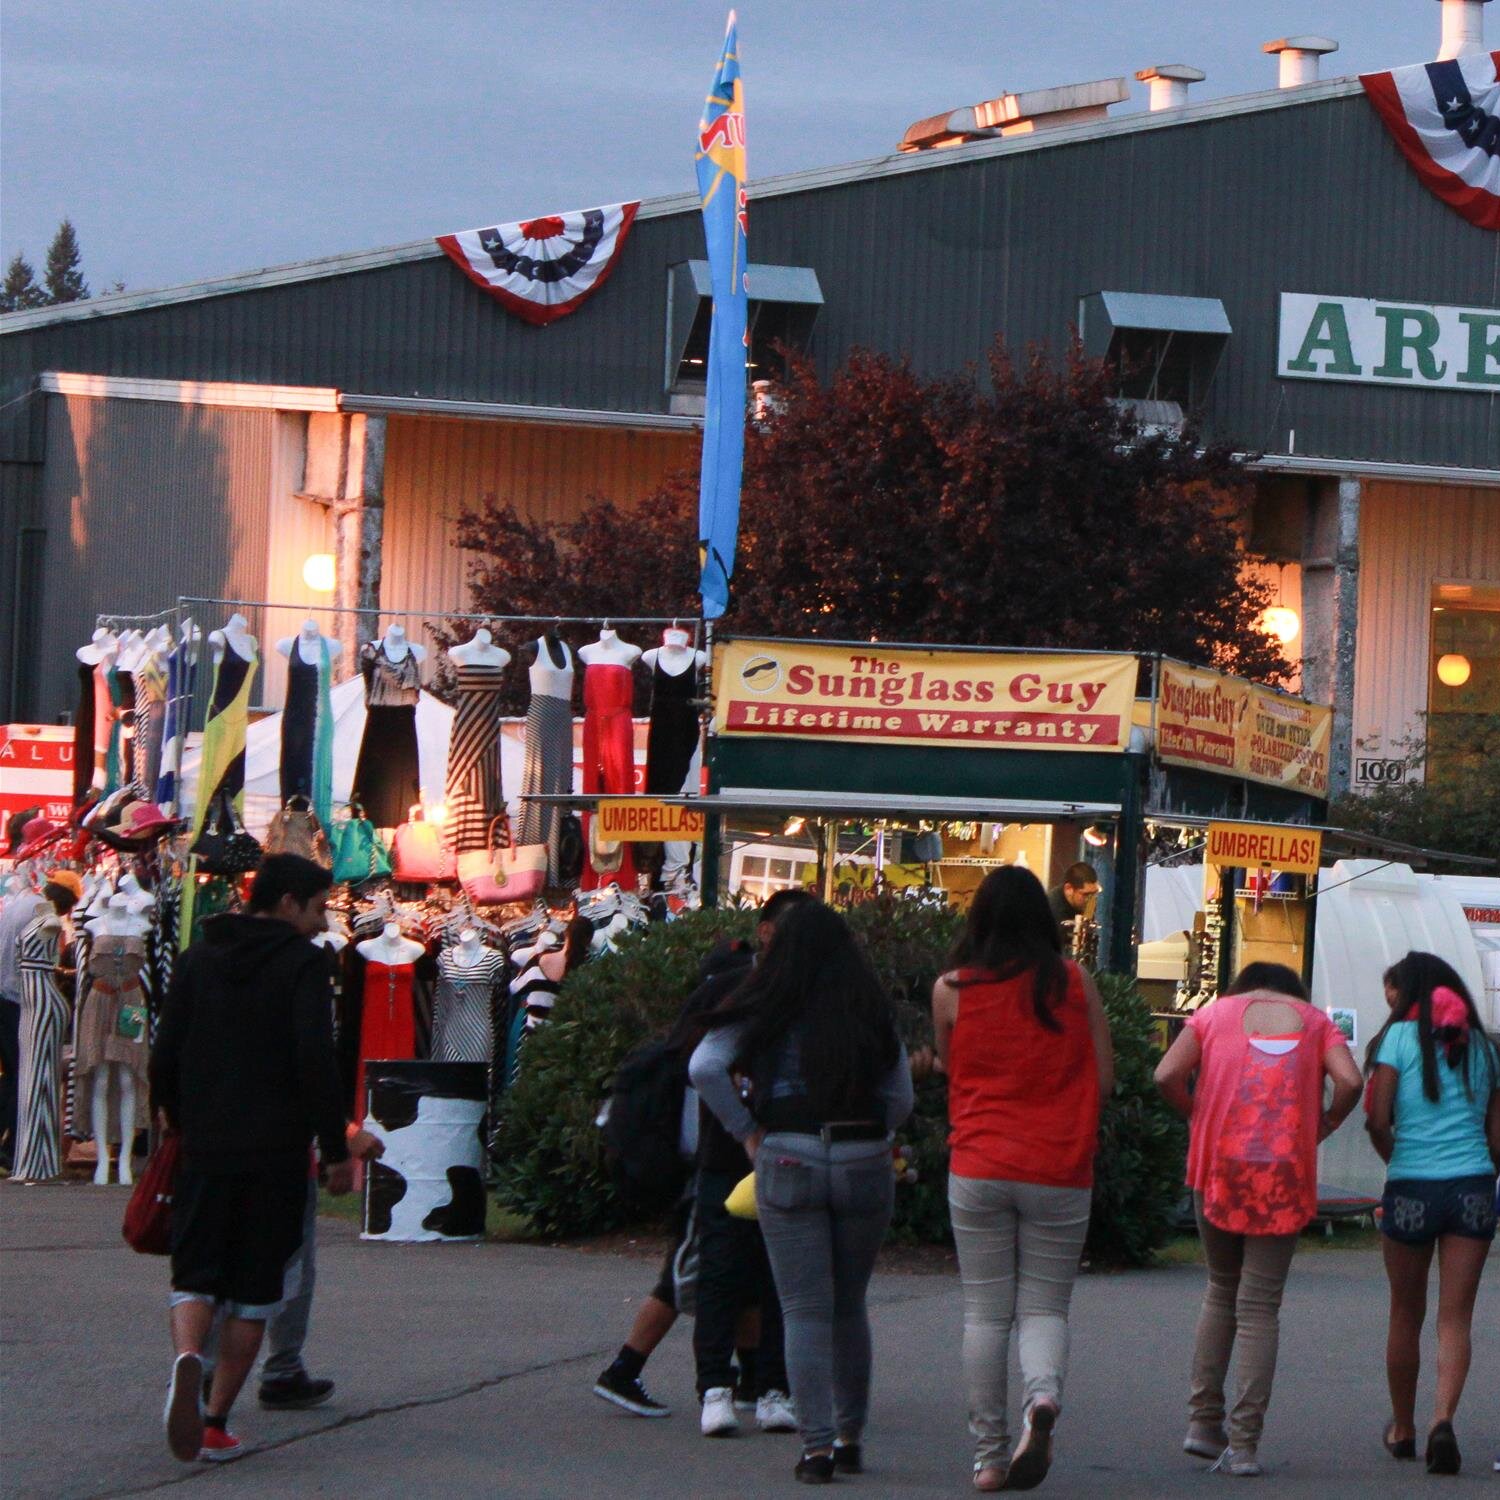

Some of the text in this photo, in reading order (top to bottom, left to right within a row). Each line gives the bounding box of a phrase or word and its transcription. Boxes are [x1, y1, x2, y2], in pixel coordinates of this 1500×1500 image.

[850, 656, 900, 676] The
[785, 664, 1108, 711] Sunglass Guy
[1161, 670, 1211, 725] Sunglass
[1213, 685, 1236, 735] Guy
[743, 706, 1101, 743] Lifetime Warranty
[1360, 762, 1401, 781] 100
[1211, 831, 1316, 865] UMBRELLAS!
